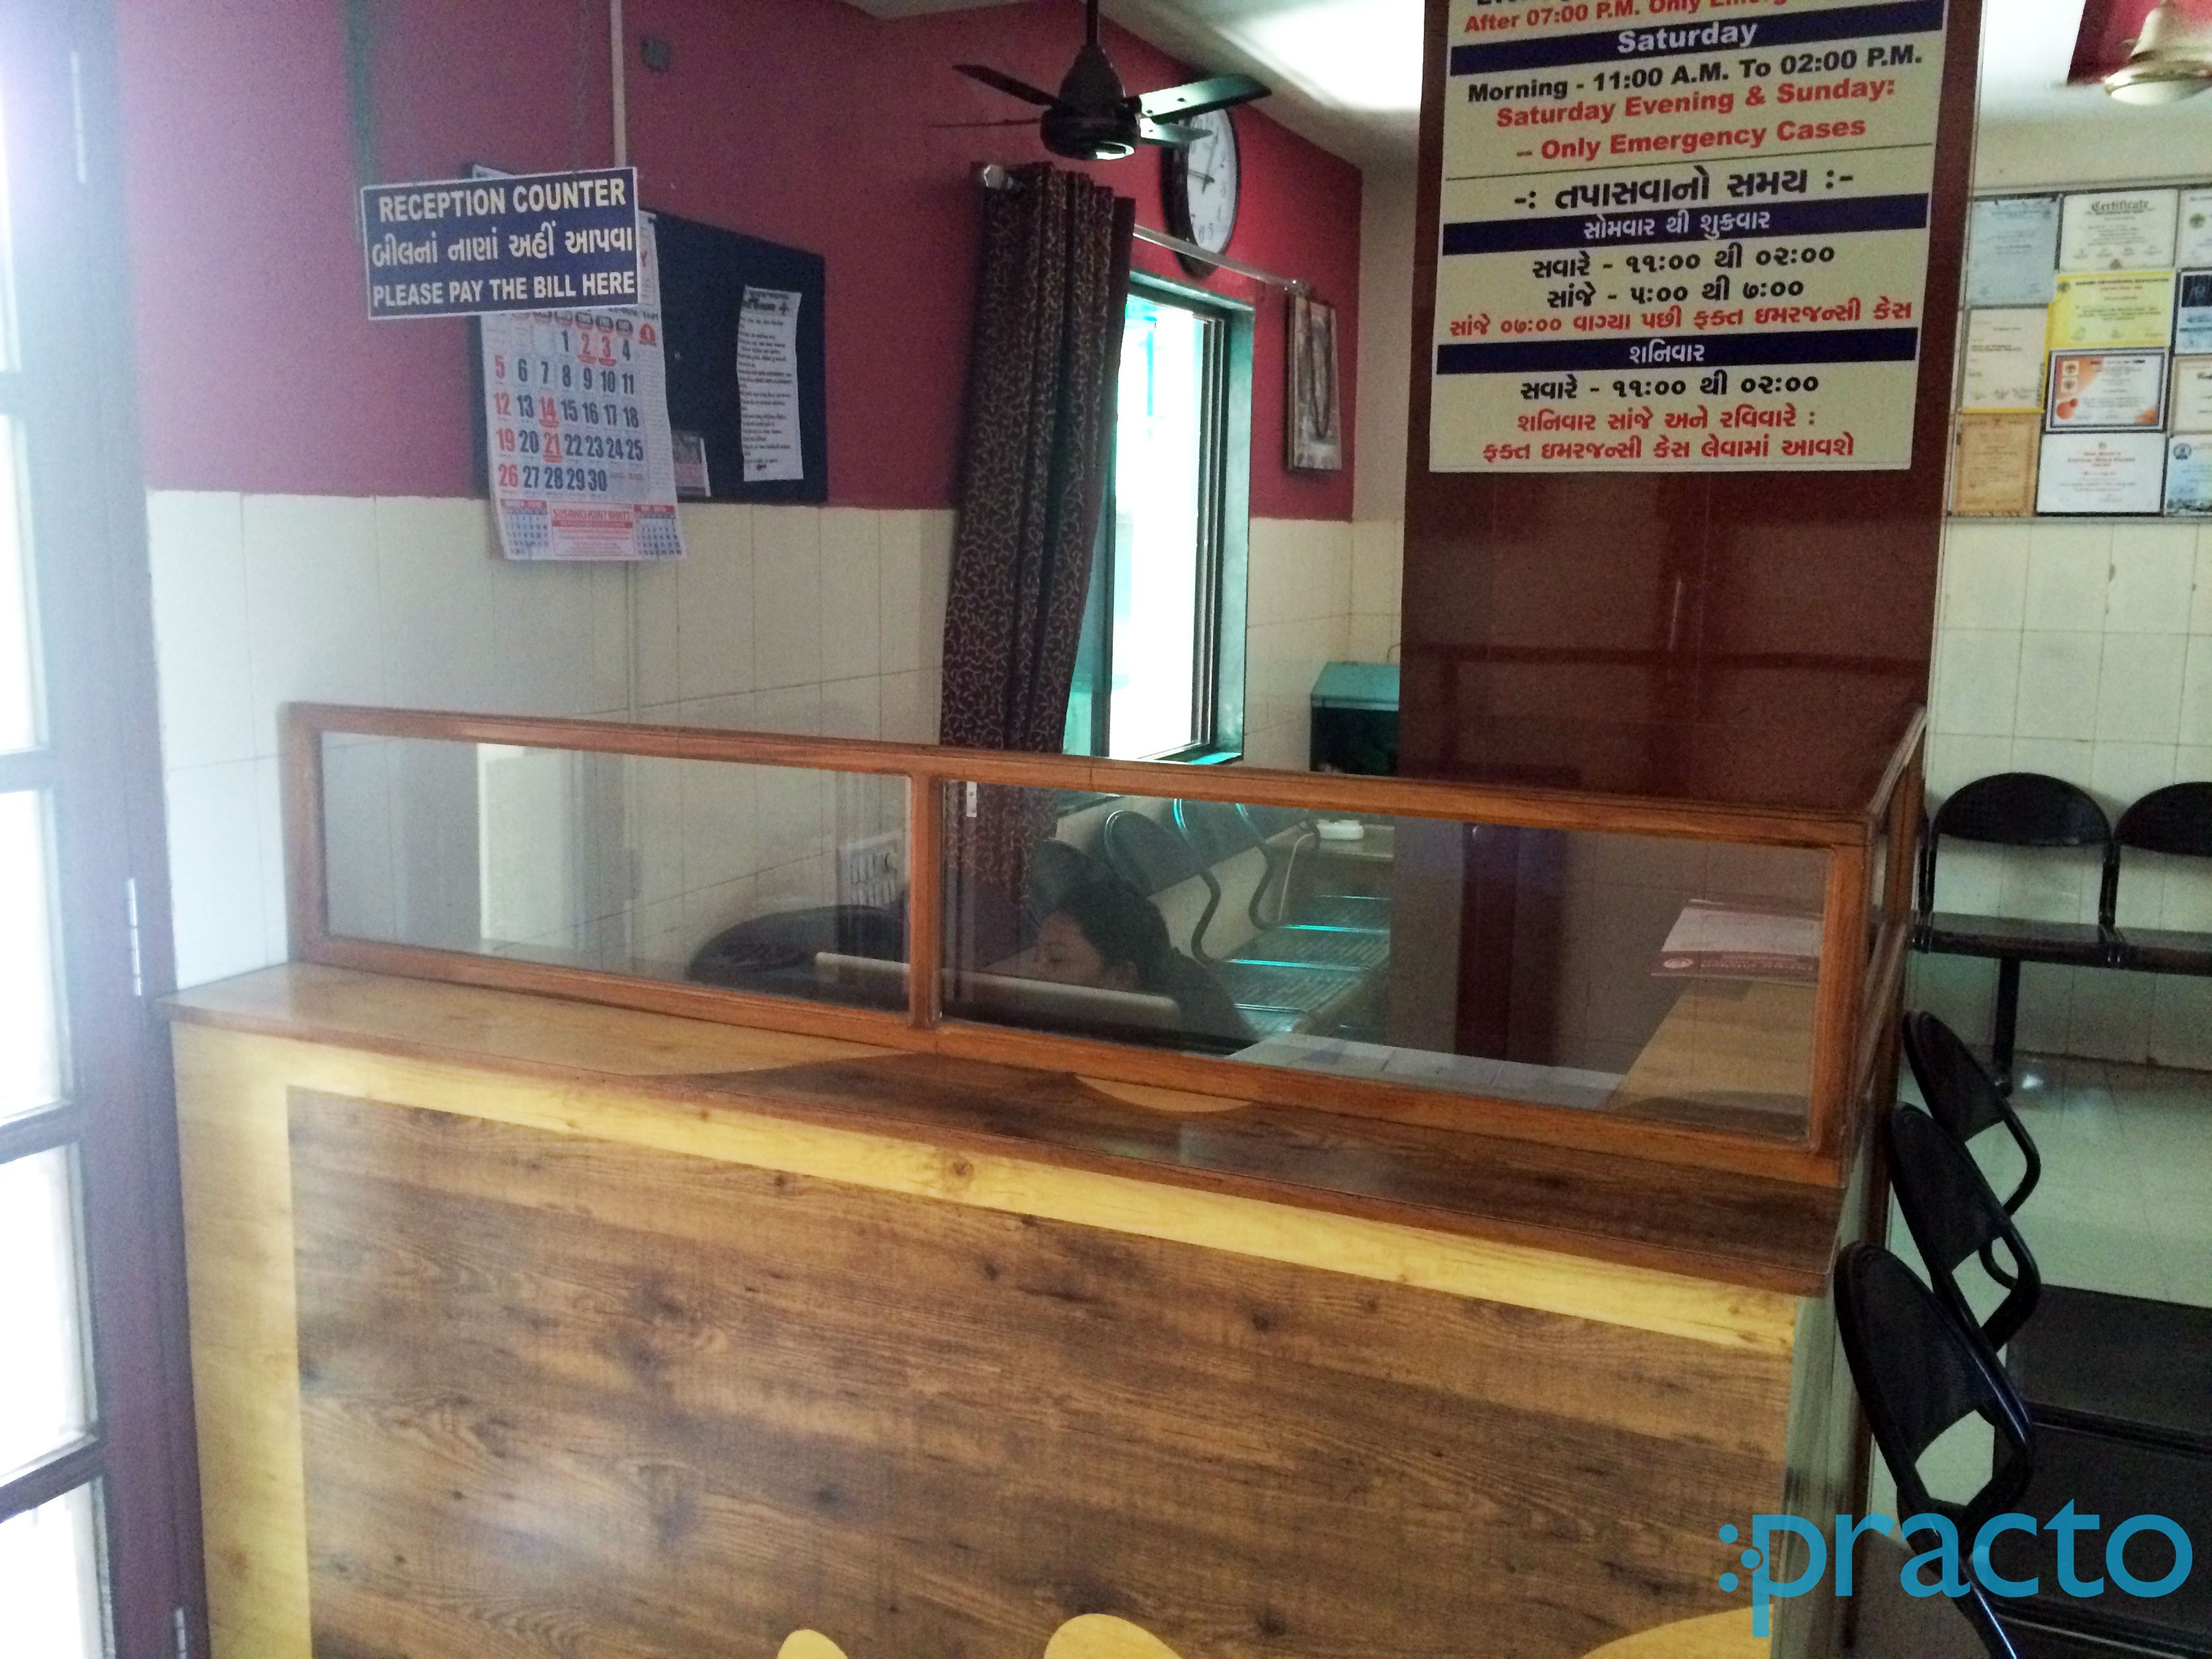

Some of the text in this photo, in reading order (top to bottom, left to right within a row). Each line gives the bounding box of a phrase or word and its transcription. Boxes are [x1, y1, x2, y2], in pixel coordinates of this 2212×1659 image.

[1465, 0, 1700, 33] After 07:00 P.M. Only
[1618, 22, 1758, 54] Saturday
[1468, 79, 1568, 102] Morning
[1593, 67, 1664, 91] 11:00
[1671, 62, 1729, 85] A.M.
[1739, 58, 1771, 79] To
[1780, 49, 1858, 75] 02:00
[1866, 44, 1923, 67] P.M.
[1496, 78, 1895, 127] Saturday Evening & Sunday:
[1541, 137, 1601, 161] Only
[1610, 127, 1767, 154] Emergency
[1777, 119, 1866, 141] Cases
[380, 178, 626, 222] RECEPTION COUNTER
[1555, 165, 1710, 209] તપાસવાનો
[1727, 168, 1807, 198] સમય
[1583, 209, 1771, 240] સોમવાર થી શુક્રવાર
[372, 220, 632, 267] બીલનાં નાણાં અહીં આપવા
[1532, 250, 1591, 278] સવારે
[1626, 253, 1701, 273] ૧૧:૦૦
[1714, 241, 1742, 268] થી
[1755, 245, 1835, 266] ૦૨:૦૦
[373, 271, 635, 307] PLEASE PAY THE BILL HERE
[1547, 281, 1597, 308] સાંજે
[1701, 274, 1730, 301] થી
[1742, 279, 1805, 299] ૭:૦૦
[1449, 313, 1491, 337] સાંજે
[1500, 318, 1562, 334] ૦૭:૦૦
[1573, 314, 1631, 331] વાગ્યા
[1641, 304, 1682, 329] પછી
[1873, 295, 1912, 320] કેસ
[562, 329, 630, 361] 1 2 3 4
[1629, 339, 1704, 363] શનિવાર
[495, 354, 635, 394] 5 6 7 8 9 10 11
[1521, 373, 1578, 400] સવારે
[1613, 379, 1686, 397] ૧૧:૦૦
[1700, 369, 1727, 395] થી
[1740, 375, 1820, 394] ૦૨:૦૦
[493, 392, 639, 428] 12 13 14 15 16 17 18
[1517, 408, 1596, 431] શનિવાર
[1607, 406, 1654, 430] સાંજે
[1664, 405, 1708, 428] અને
[1720, 403, 1797, 428] રવિવારે
[497, 428, 644, 462] 19 20 21 22 23 24 25
[1653, 434, 1690, 458] કેસ
[1701, 432, 1769, 458] લેવામાં
[1781, 430, 1854, 457] આવશે
[498, 464, 607, 491] 26 27 28 29 30
